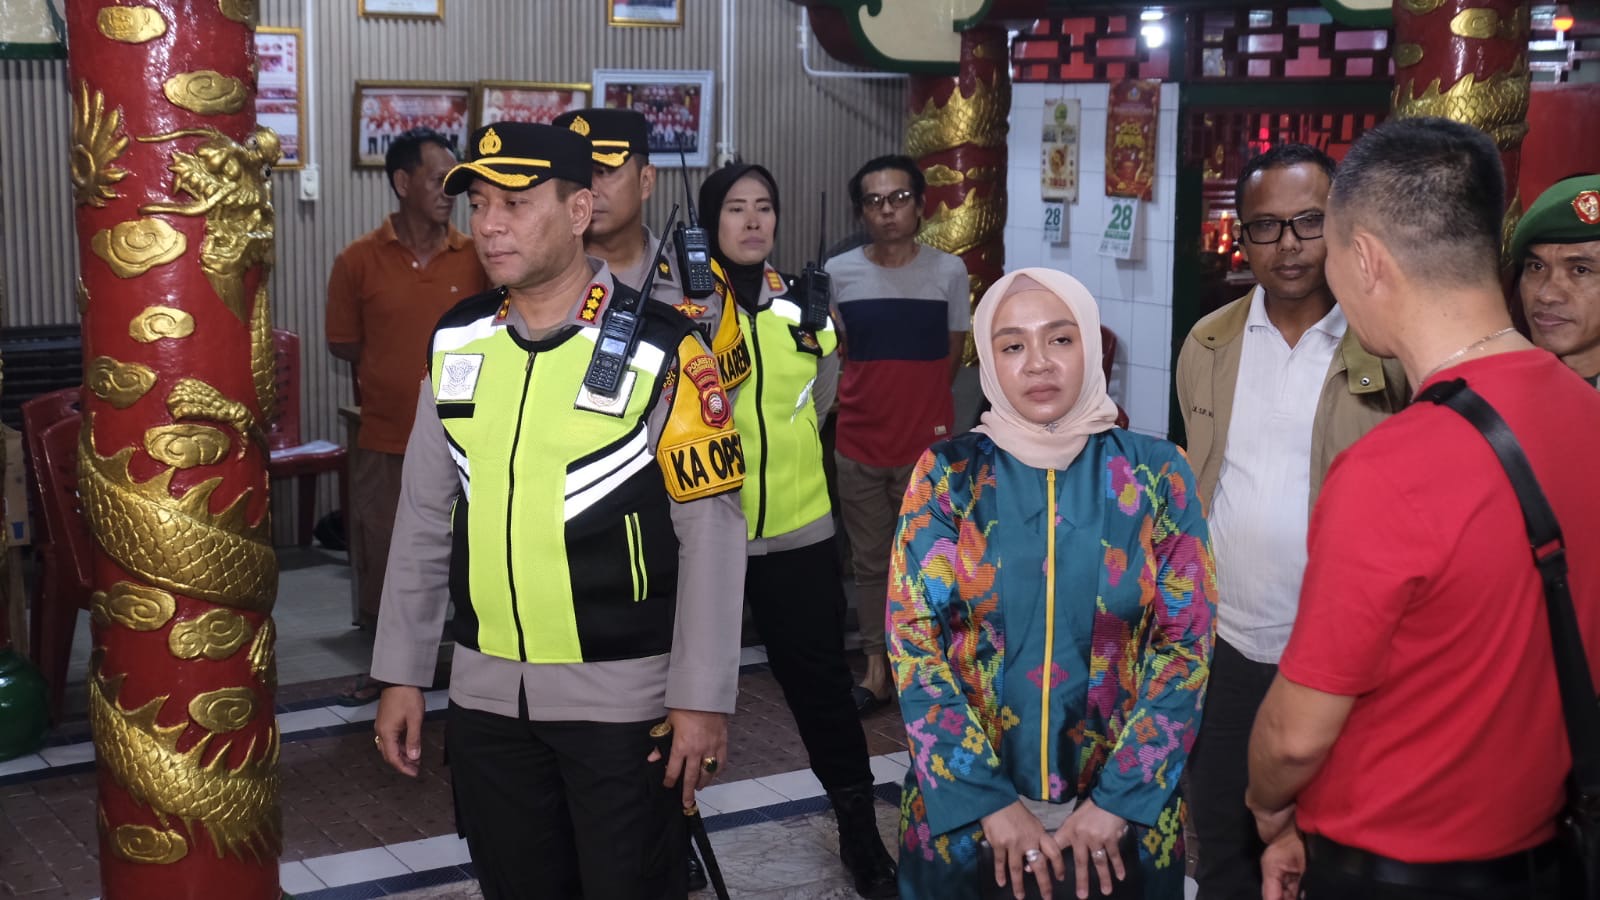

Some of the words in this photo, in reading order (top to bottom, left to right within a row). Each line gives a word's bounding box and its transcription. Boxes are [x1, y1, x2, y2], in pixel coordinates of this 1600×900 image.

[1045, 207, 1061, 226] 28
[1107, 203, 1132, 231] 28
[670, 446, 710, 491] KA
[708, 434, 746, 480] OPS
